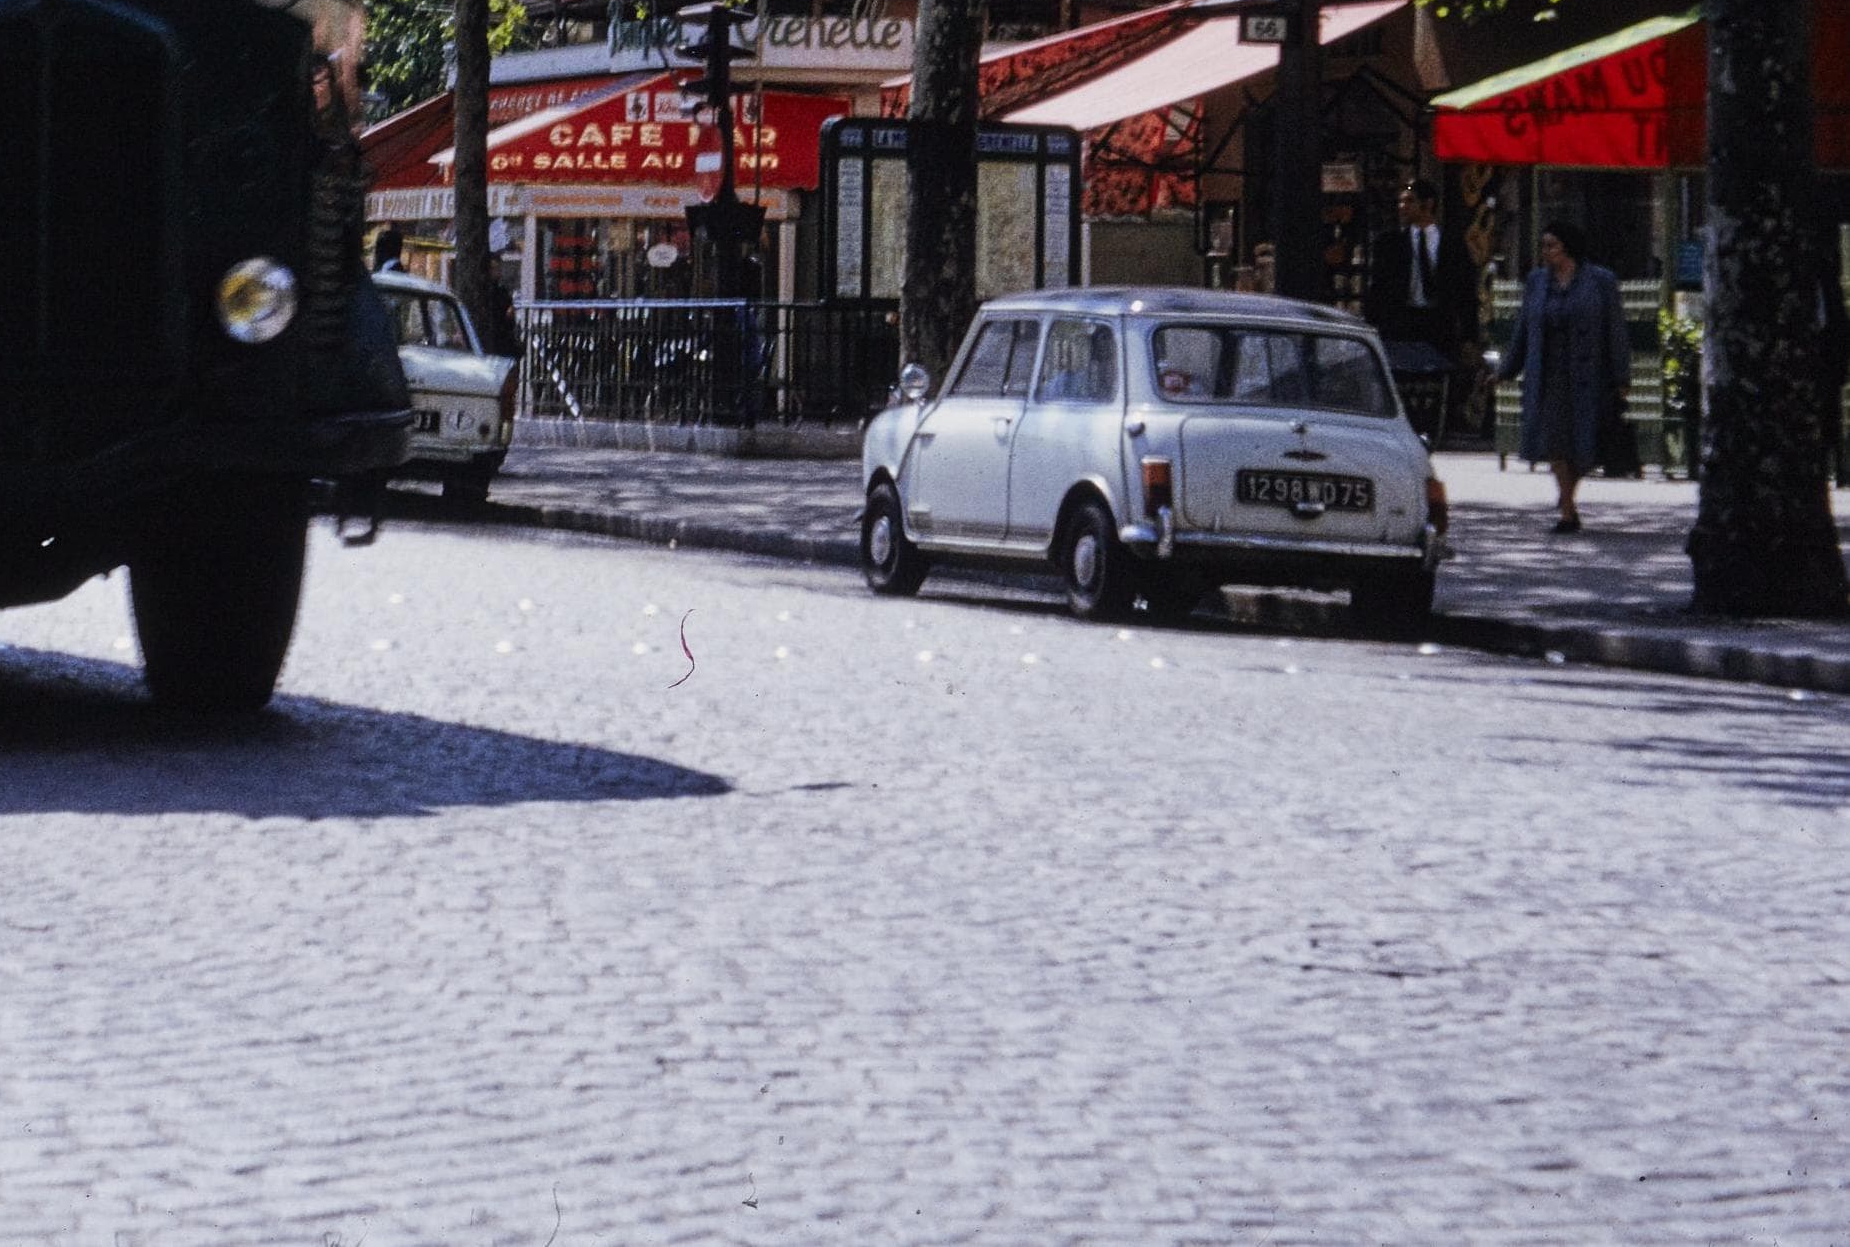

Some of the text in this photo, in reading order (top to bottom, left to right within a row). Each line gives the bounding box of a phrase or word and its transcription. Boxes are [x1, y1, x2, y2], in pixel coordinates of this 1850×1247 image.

[550, 123, 664, 147] CAFE
[533, 153, 627, 170] SALLE
[641, 153, 684, 170] AU
